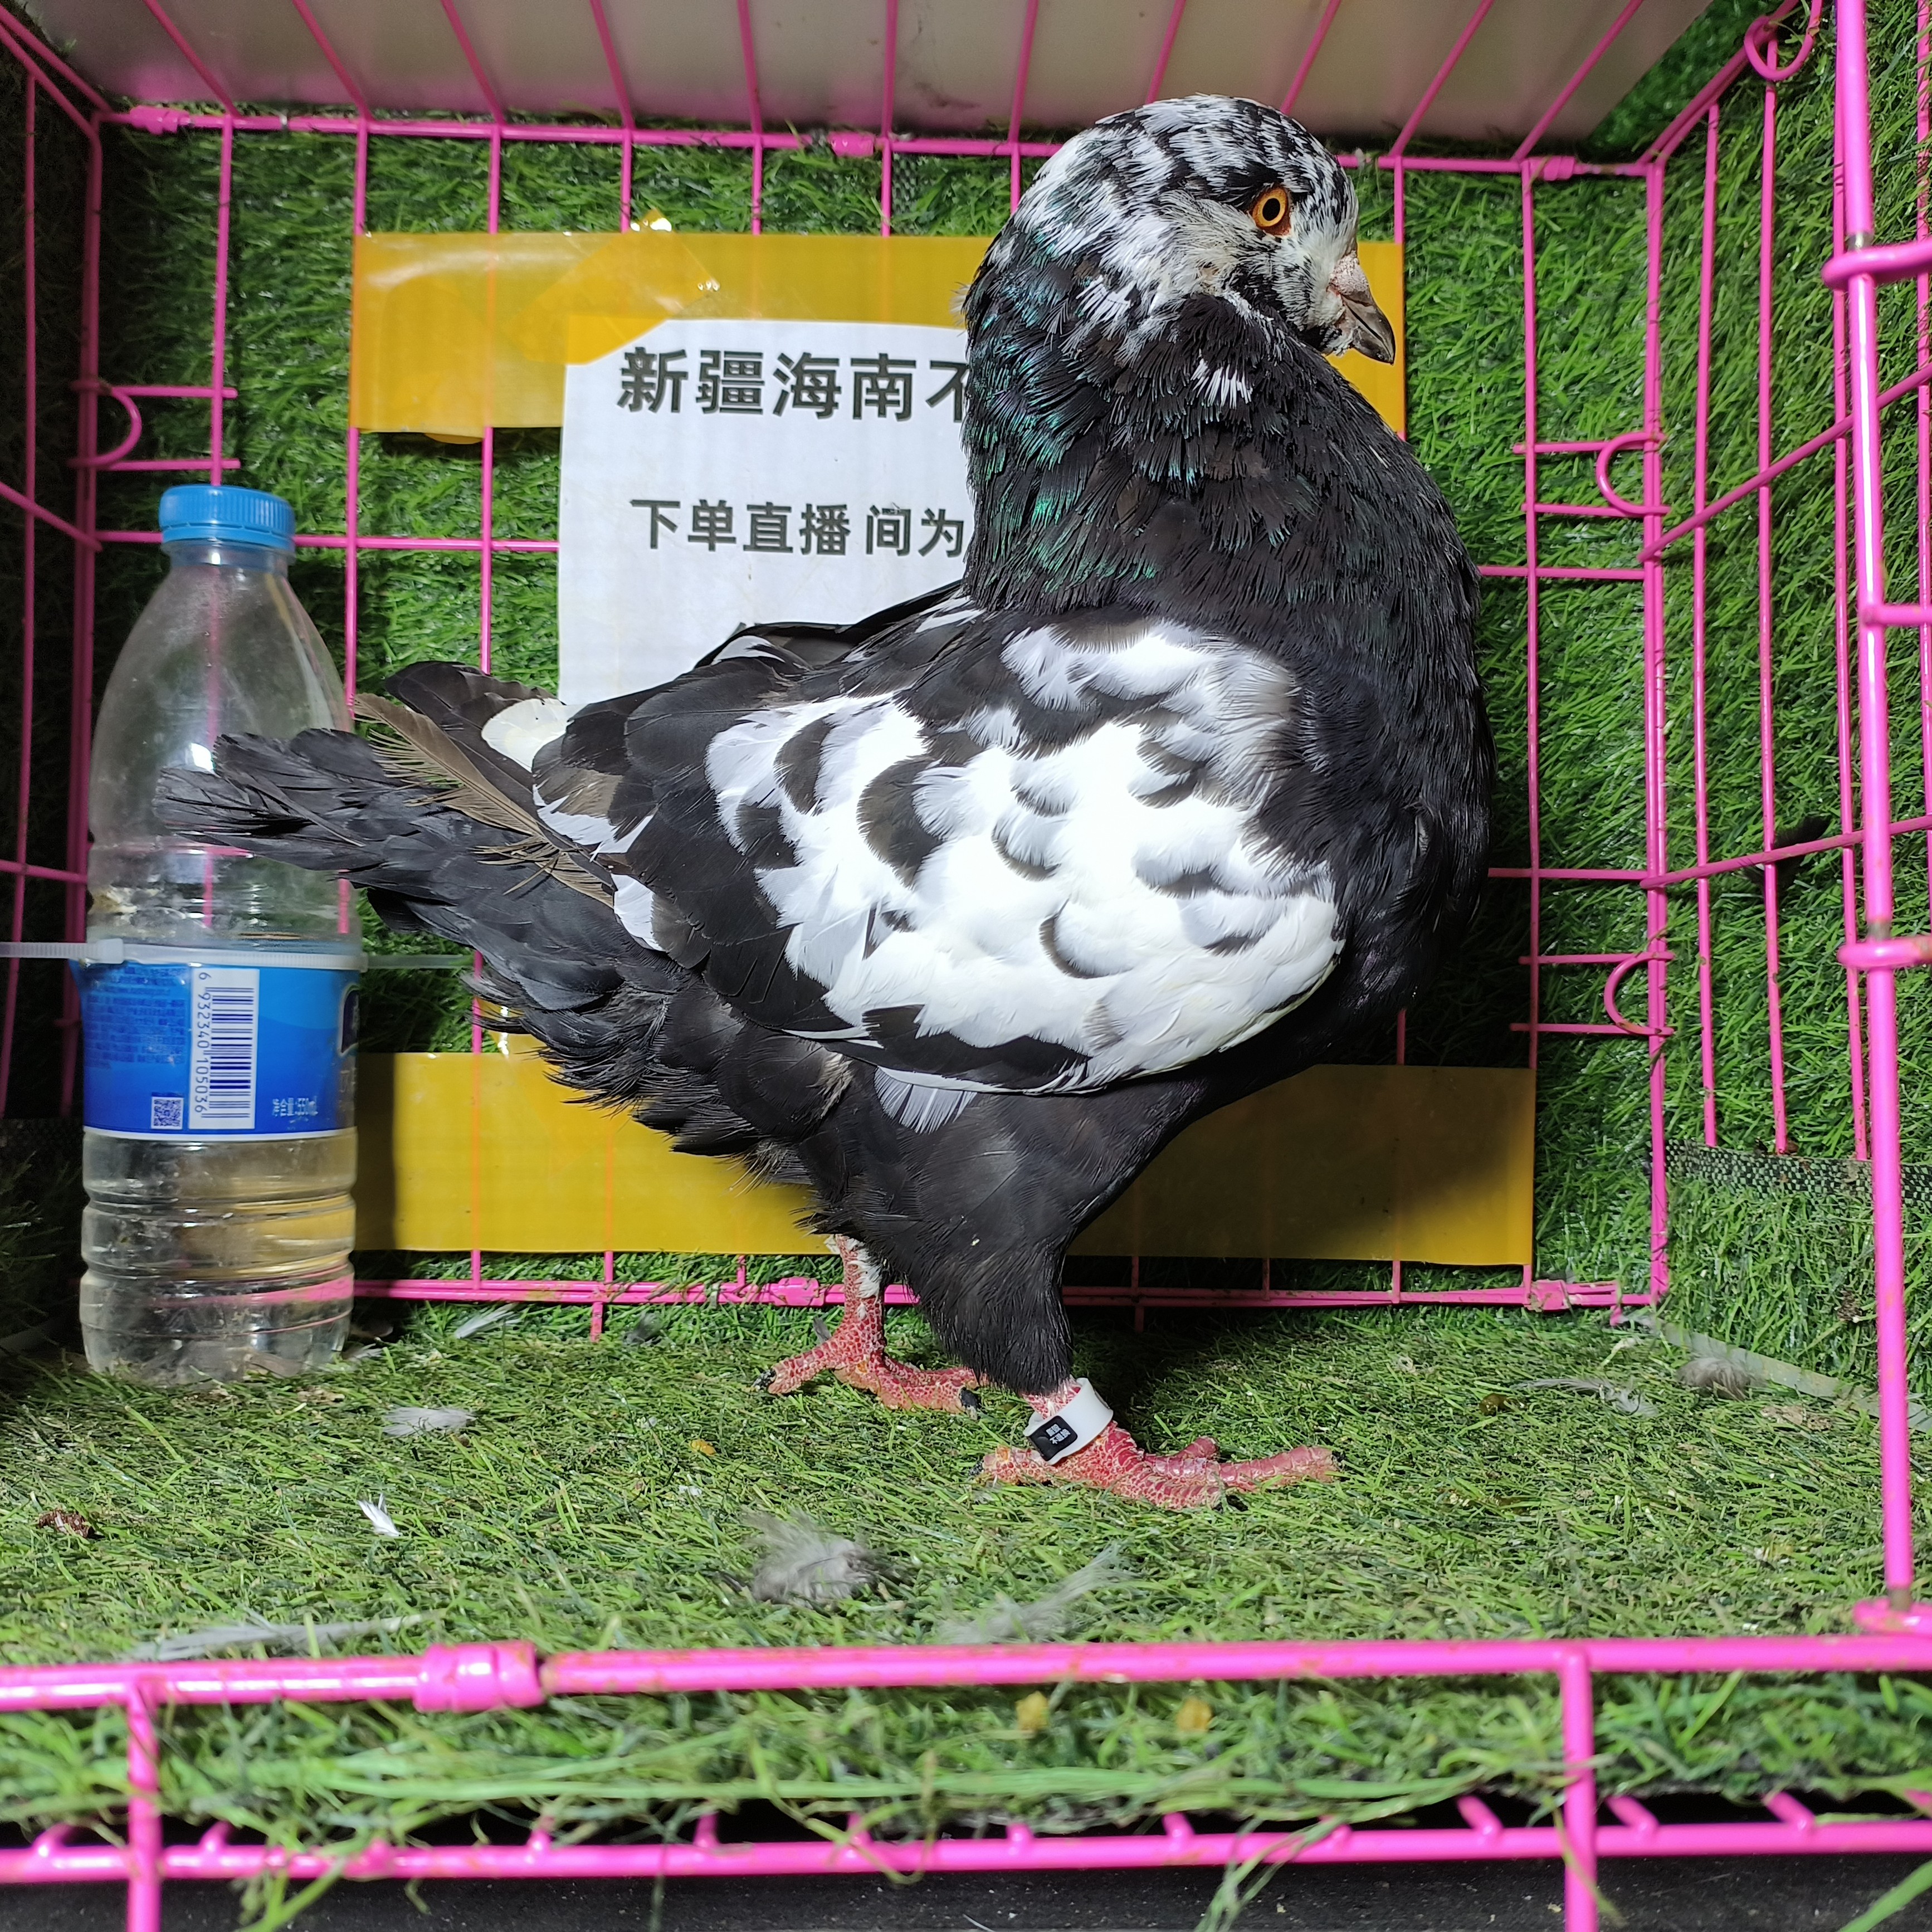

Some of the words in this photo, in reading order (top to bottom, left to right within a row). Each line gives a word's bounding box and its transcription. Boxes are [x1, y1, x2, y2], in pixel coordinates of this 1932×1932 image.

[617, 346, 969, 423] 新疆海南不
[630, 499, 964, 558] 下单直播间为
[197, 992, 211, 1048] 932340
[194, 1057, 209, 1113] 105036
